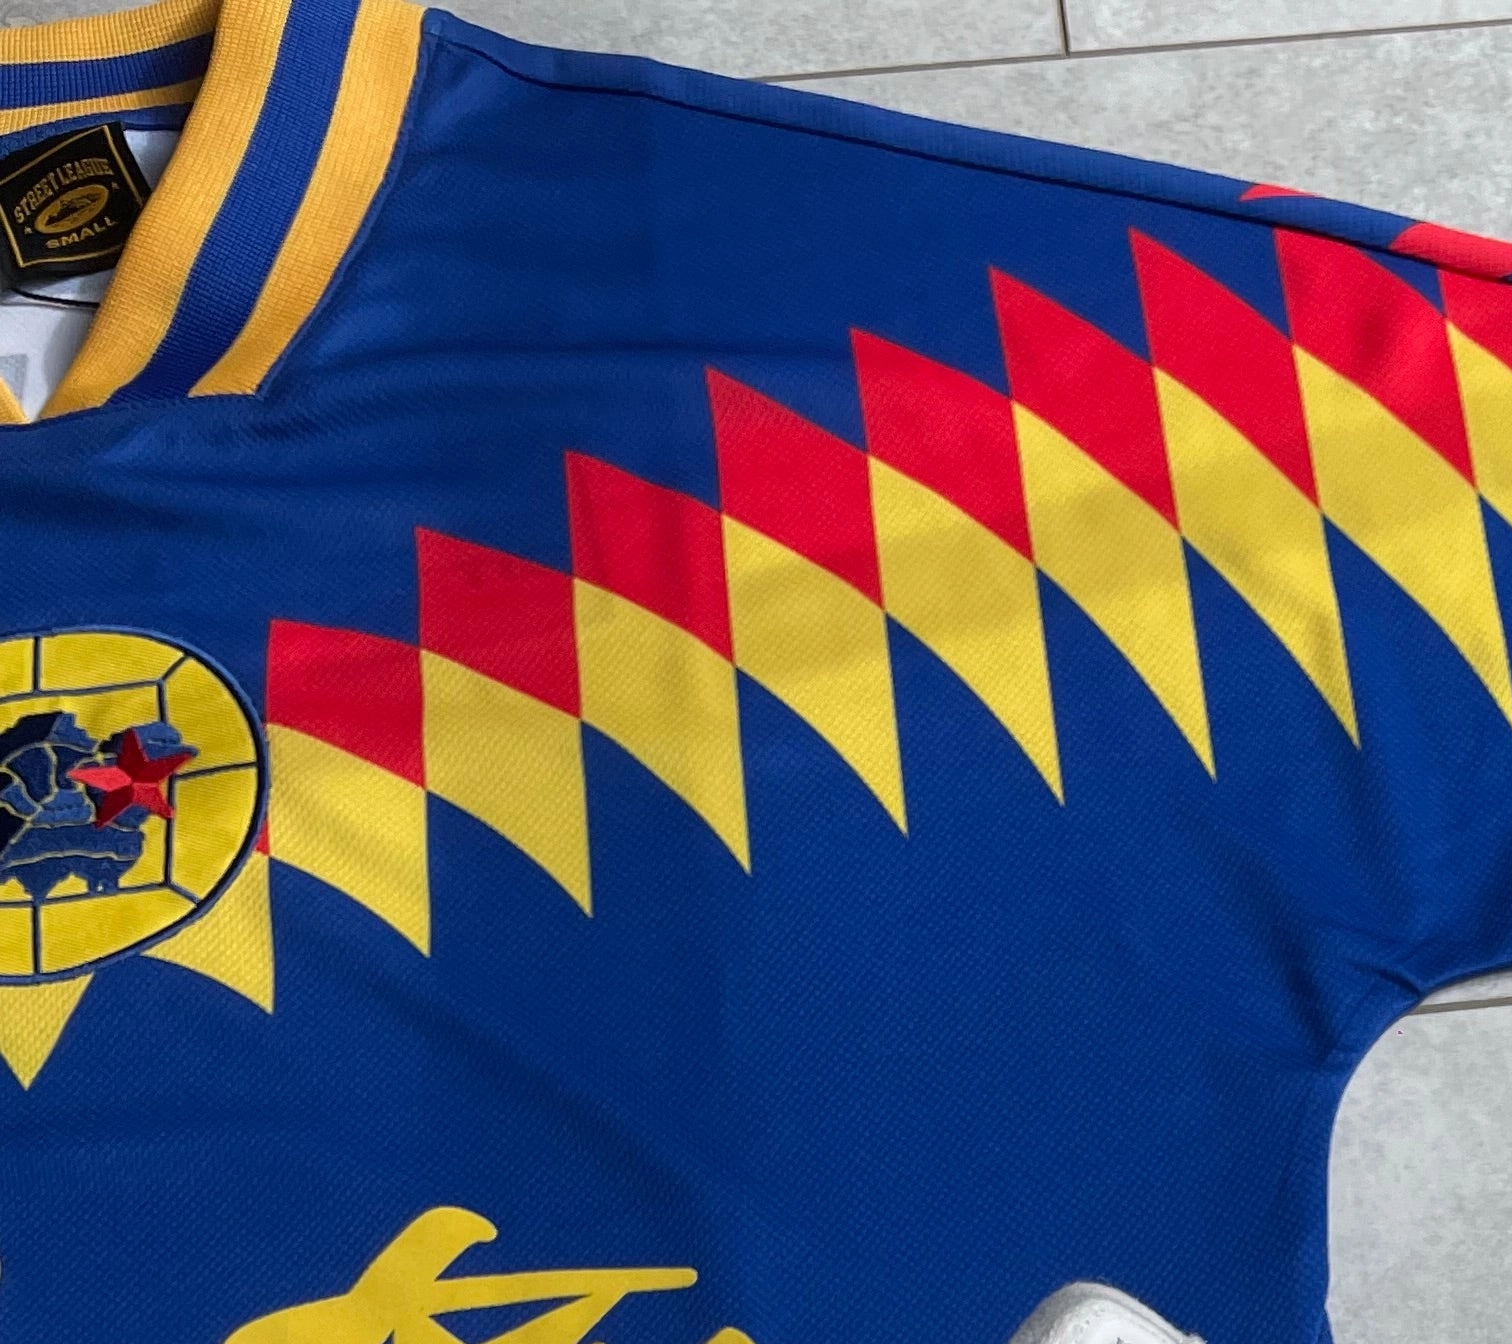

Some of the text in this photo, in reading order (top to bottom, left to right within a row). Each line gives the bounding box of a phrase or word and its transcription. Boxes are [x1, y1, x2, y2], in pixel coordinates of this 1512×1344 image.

[13, 157, 114, 223] STREET LEAGUE
[45, 216, 118, 249] SMALL
